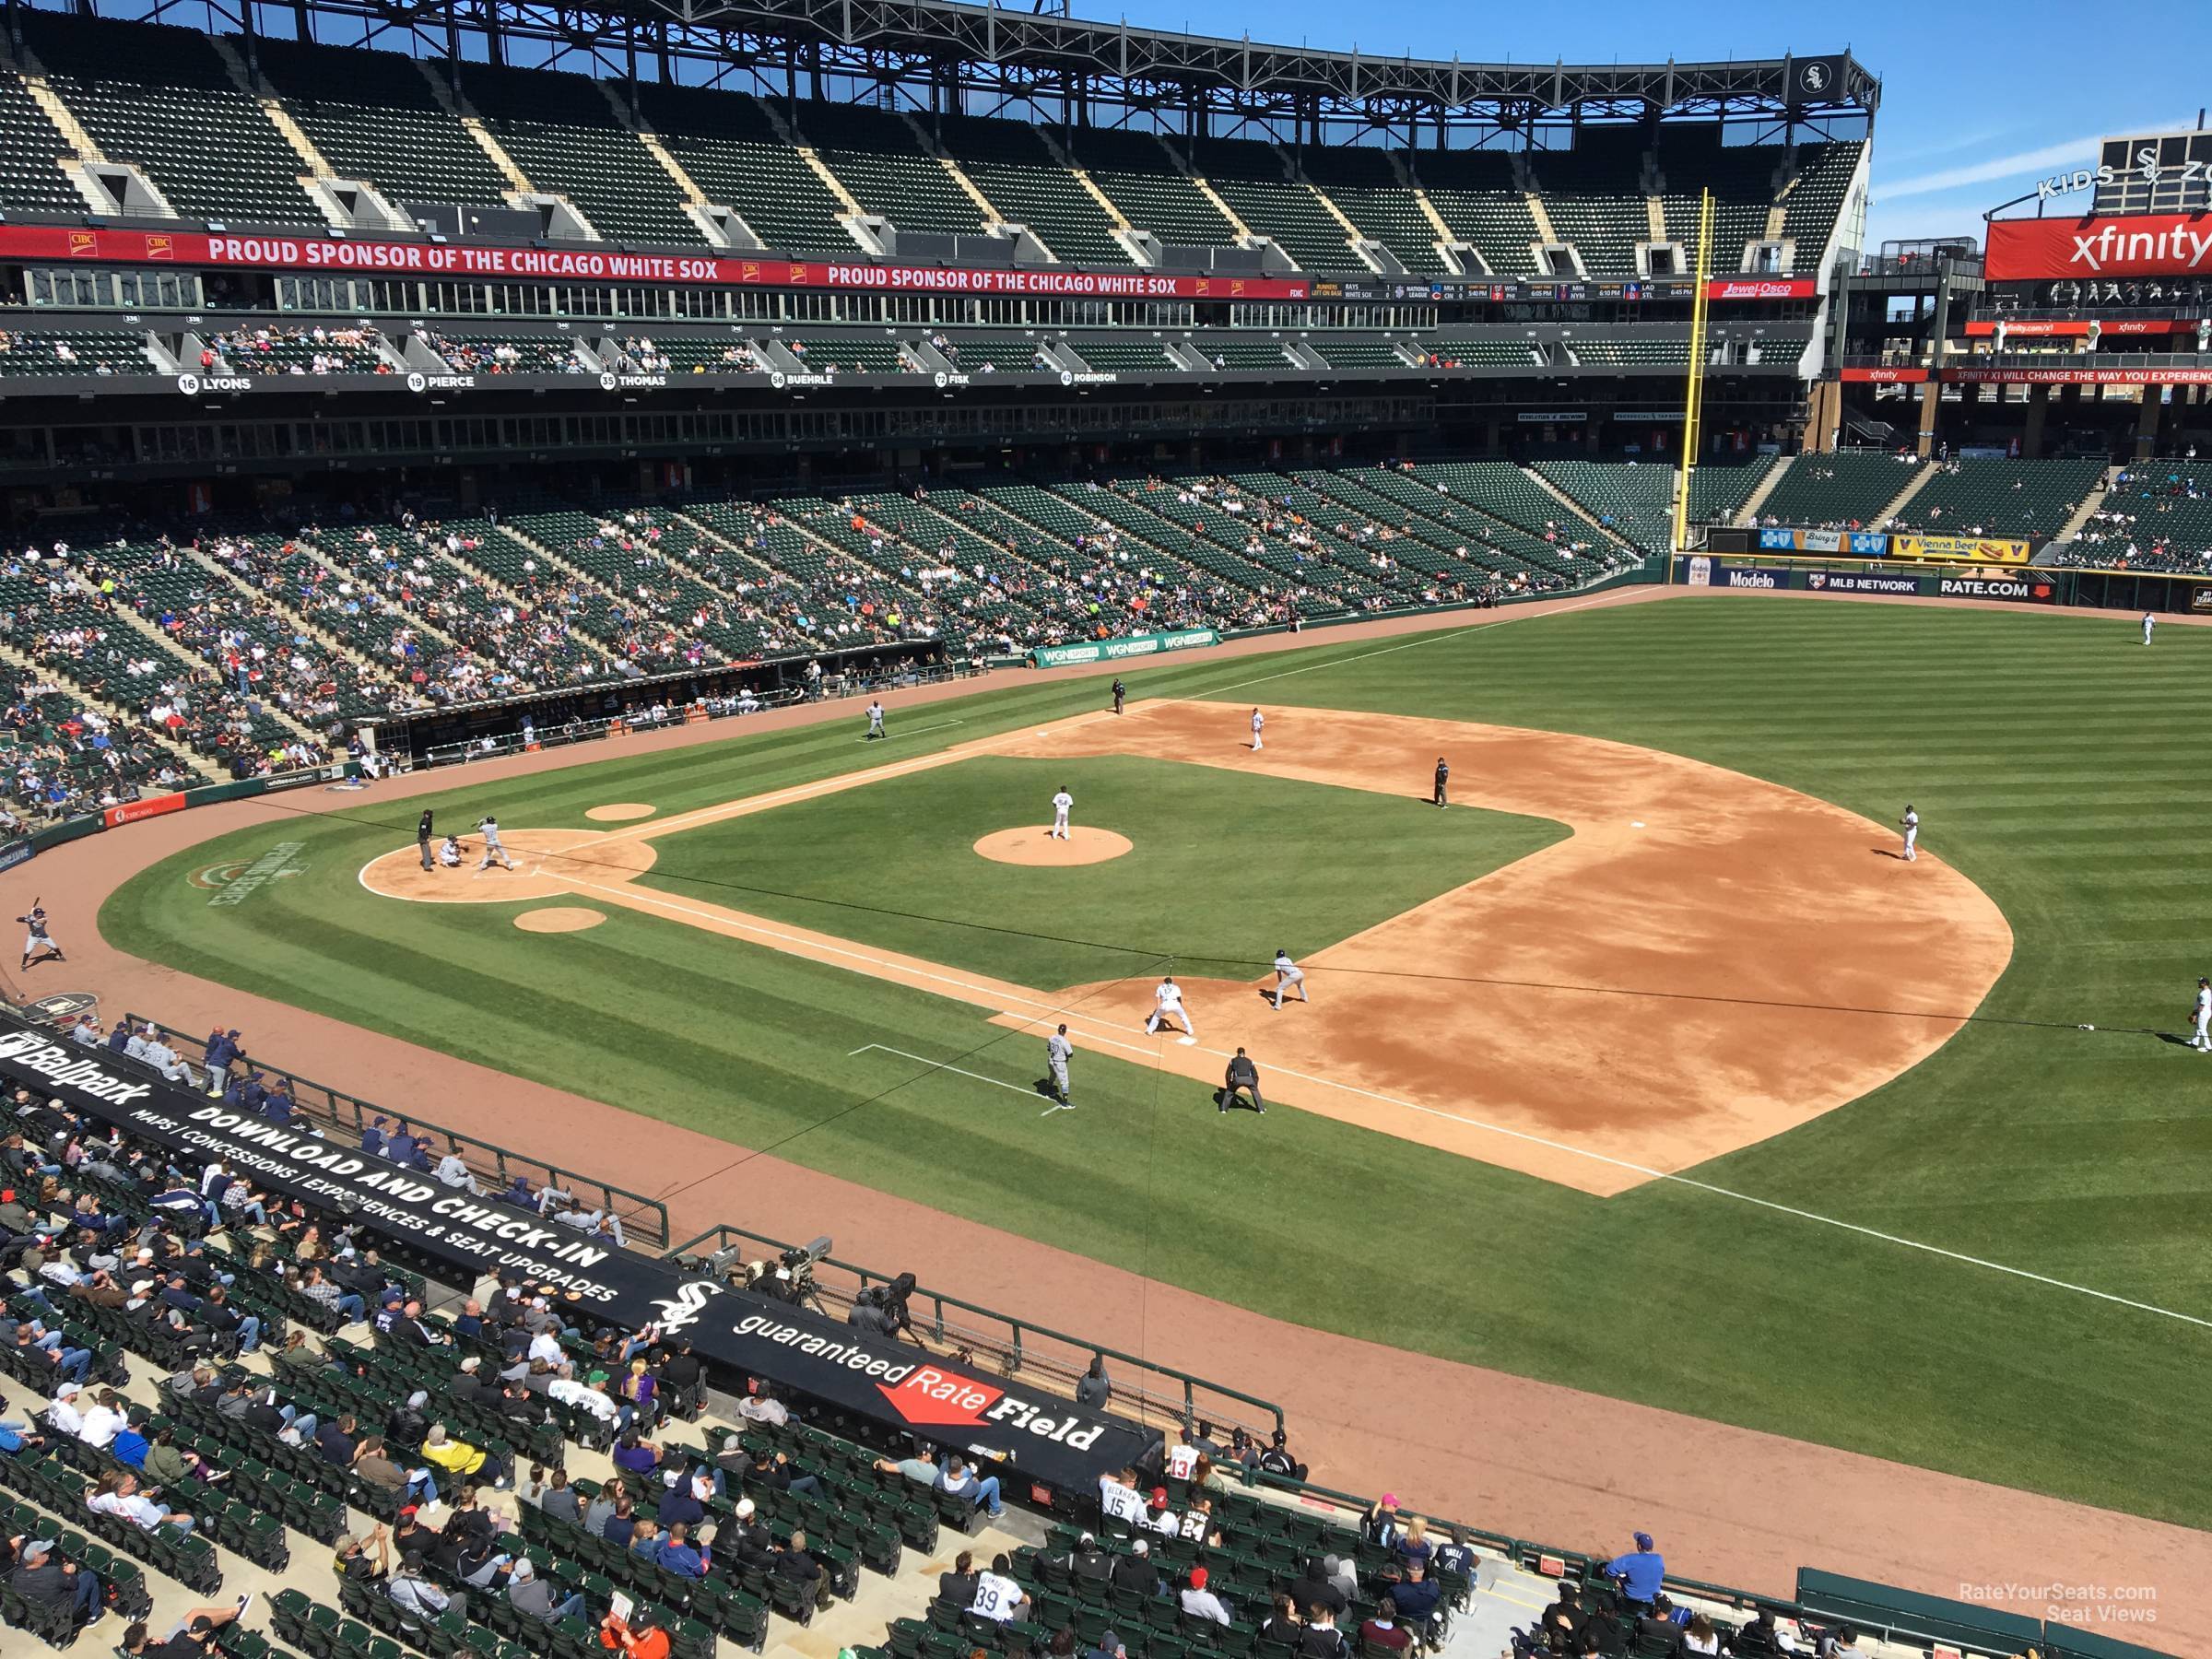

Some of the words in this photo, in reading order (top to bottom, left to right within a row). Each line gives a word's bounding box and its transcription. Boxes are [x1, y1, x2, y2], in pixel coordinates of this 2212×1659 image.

[2036, 165, 2115, 201] KIDS
[71, 234, 95, 244] CIBC
[147, 237, 171, 247] CIBC
[2070, 223, 2212, 271] xfinity
[208, 238, 299, 263] PROUD
[306, 242, 422, 267] SPONSOR
[428, 248, 456, 269] OF
[463, 250, 506, 271] THE
[511, 252, 604, 275] CHICAGO
[608, 256, 675, 277] WHITE
[679, 261, 718, 279] SOX
[829, 266, 887, 286] PROUD
[891, 269, 969, 288] SPONSOR
[972, 272, 992, 288] OF
[996, 273, 1025, 290] THE
[1029, 275, 1094, 291] CHICAGO
[1098, 276, 1145, 293] WHITE
[1148, 278, 1176, 294] SOX
[1290, 288, 1303, 298] FDIC
[1723, 283, 1792, 294] Jewel-Osco
[2006, 323, 2053, 334] finity.com/x1
[2119, 323, 2147, 332] xfinity
[603, 376, 614, 385] 35
[618, 376, 666, 386] THOMAS
[772, 376, 783, 384] 56
[787, 375, 833, 385] BUEHRLE
[936, 375, 946, 384] 72
[948, 375, 970, 384] FISK
[1062, 374, 1071, 382] 42
[1074, 373, 1116, 382] ROBINSON
[1869, 369, 1899, 381] xfinity
[1958, 371, 1992, 380] XFINITY
[1991, 371, 2001, 379] X1
[2003, 371, 2025, 380] WILL
[2028, 371, 2070, 381] CHANGE
[2074, 371, 2095, 381] THE
[2097, 371, 2122, 381] WAY
[2124, 371, 2149, 381] YOU
[182, 378, 195, 390] 16
[203, 378, 251, 391] LYONS
[410, 377, 422, 388] 19
[428, 376, 475, 387] PIERCE
[1806, 532, 1830, 544] Bring
[1916, 537, 1952, 549] Vienna
[1955, 539, 1978, 550] Beef
[1730, 571, 1775, 588] Modelo
[1830, 577, 1854, 588] MLB
[1857, 579, 1915, 592] NETWORK
[1941, 580, 2028, 598] RATE.COM
[1164, 635, 1188, 648] WGN
[1106, 643, 1131, 655] WGN
[1044, 650, 1072, 662] WGN
[266, 773, 313, 787] whitesox.com
[1051, 1042, 1060, 1054] 30
[12, 1046, 152, 1106] Ballpark
[188, 1107, 364, 1175] DOWNLOAD
[354, 1171, 435, 1203] AND
[431, 1197, 609, 1269] CHECK-IN
[129, 1109, 178, 1131] MAPS
[181, 1129, 298, 1182] CONCESSIONS
[425, 1226, 446, 1237] &
[445, 1233, 501, 1258] SEAT
[498, 1252, 619, 1303] UPGRADES
[733, 1314, 916, 1384] guaranteed
[906, 1364, 986, 1411] Rate
[986, 1397, 1105, 1453] Field
[1171, 1459, 1189, 1477] 13
[1108, 1486, 1136, 1503] BECKHAM
[1110, 1497, 1126, 1516] 15
[1181, 1518, 1206, 1542] 24
[1444, 1558, 1458, 1572] 4
[975, 1585, 999, 1612] 39
